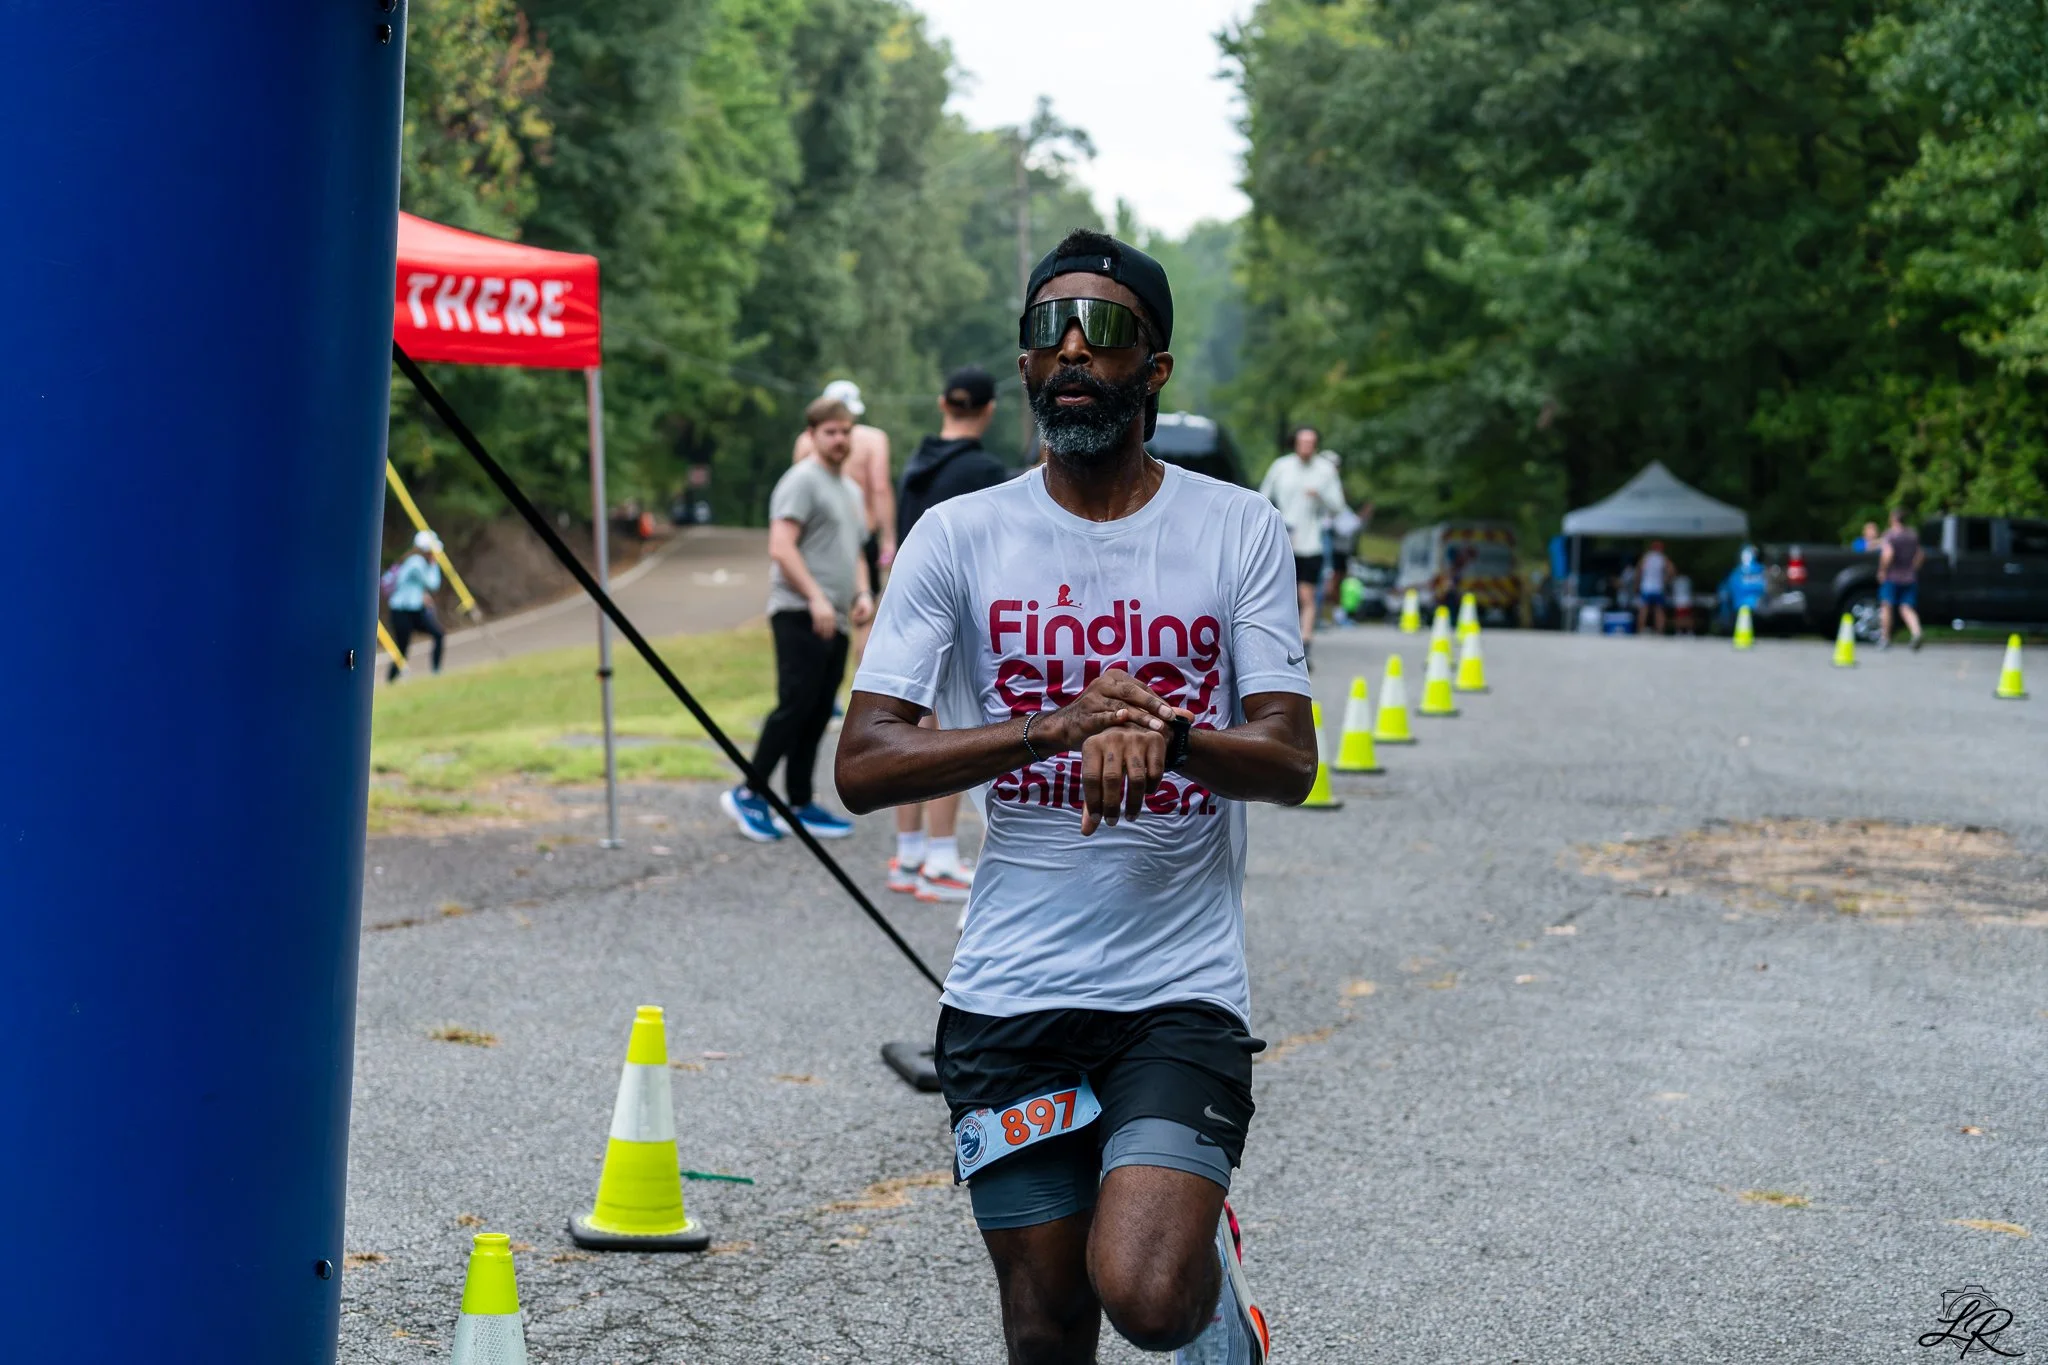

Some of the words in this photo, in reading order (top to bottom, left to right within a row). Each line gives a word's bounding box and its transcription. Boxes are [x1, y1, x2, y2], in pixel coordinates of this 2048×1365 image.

[407, 272, 566, 337] THERE
[989, 599, 1221, 671] Finding
[994, 660, 1220, 714] cues.
[992, 759, 1216, 815] chilen.
[1001, 1089, 1077, 1146] 897
